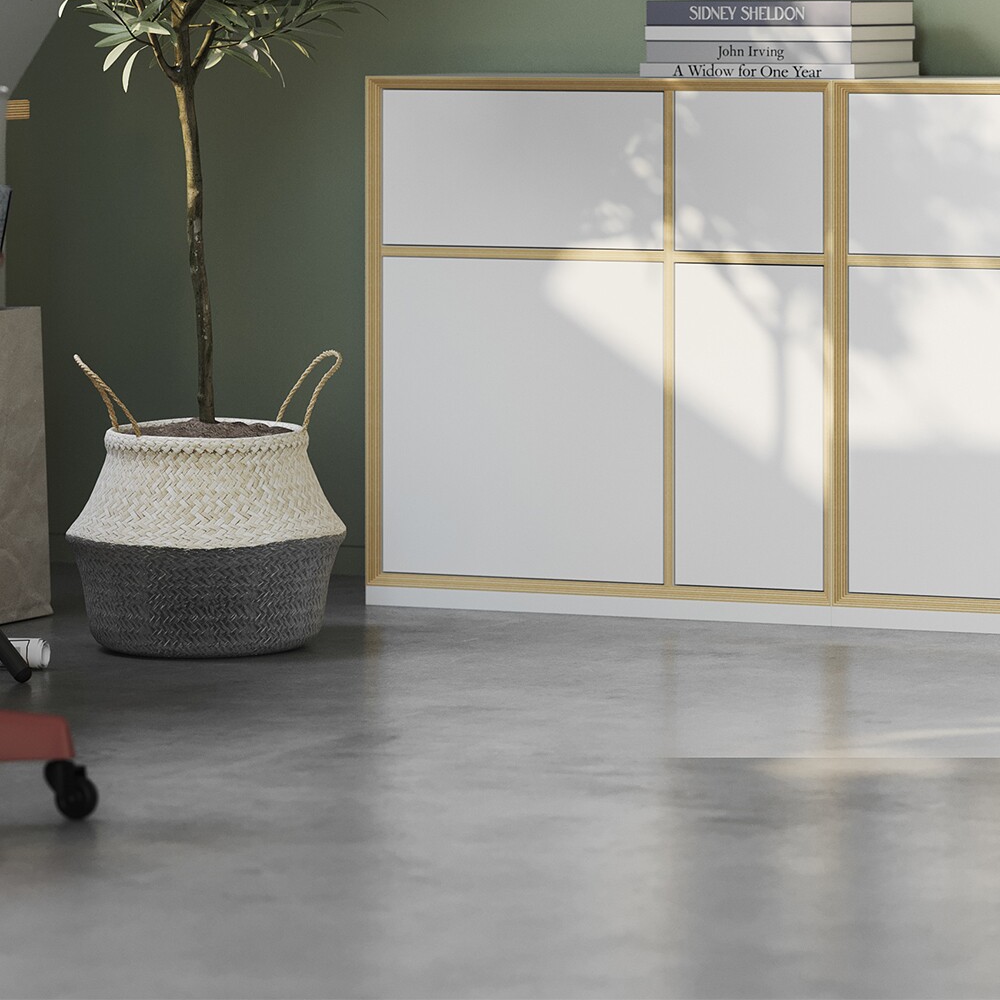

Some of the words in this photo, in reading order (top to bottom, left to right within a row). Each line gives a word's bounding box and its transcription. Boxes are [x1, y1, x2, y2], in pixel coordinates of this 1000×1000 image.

[688, 6, 738, 21] SIDNEY
[740, 6, 806, 21] SHELDON
[716, 45, 745, 60] John
[748, 46, 785, 60] Irving
[673, 64, 684, 78] A
[688, 63, 734, 78] Widow
[738, 62, 758, 78] for
[760, 65, 790, 78] One
[792, 65, 823, 78] Year
